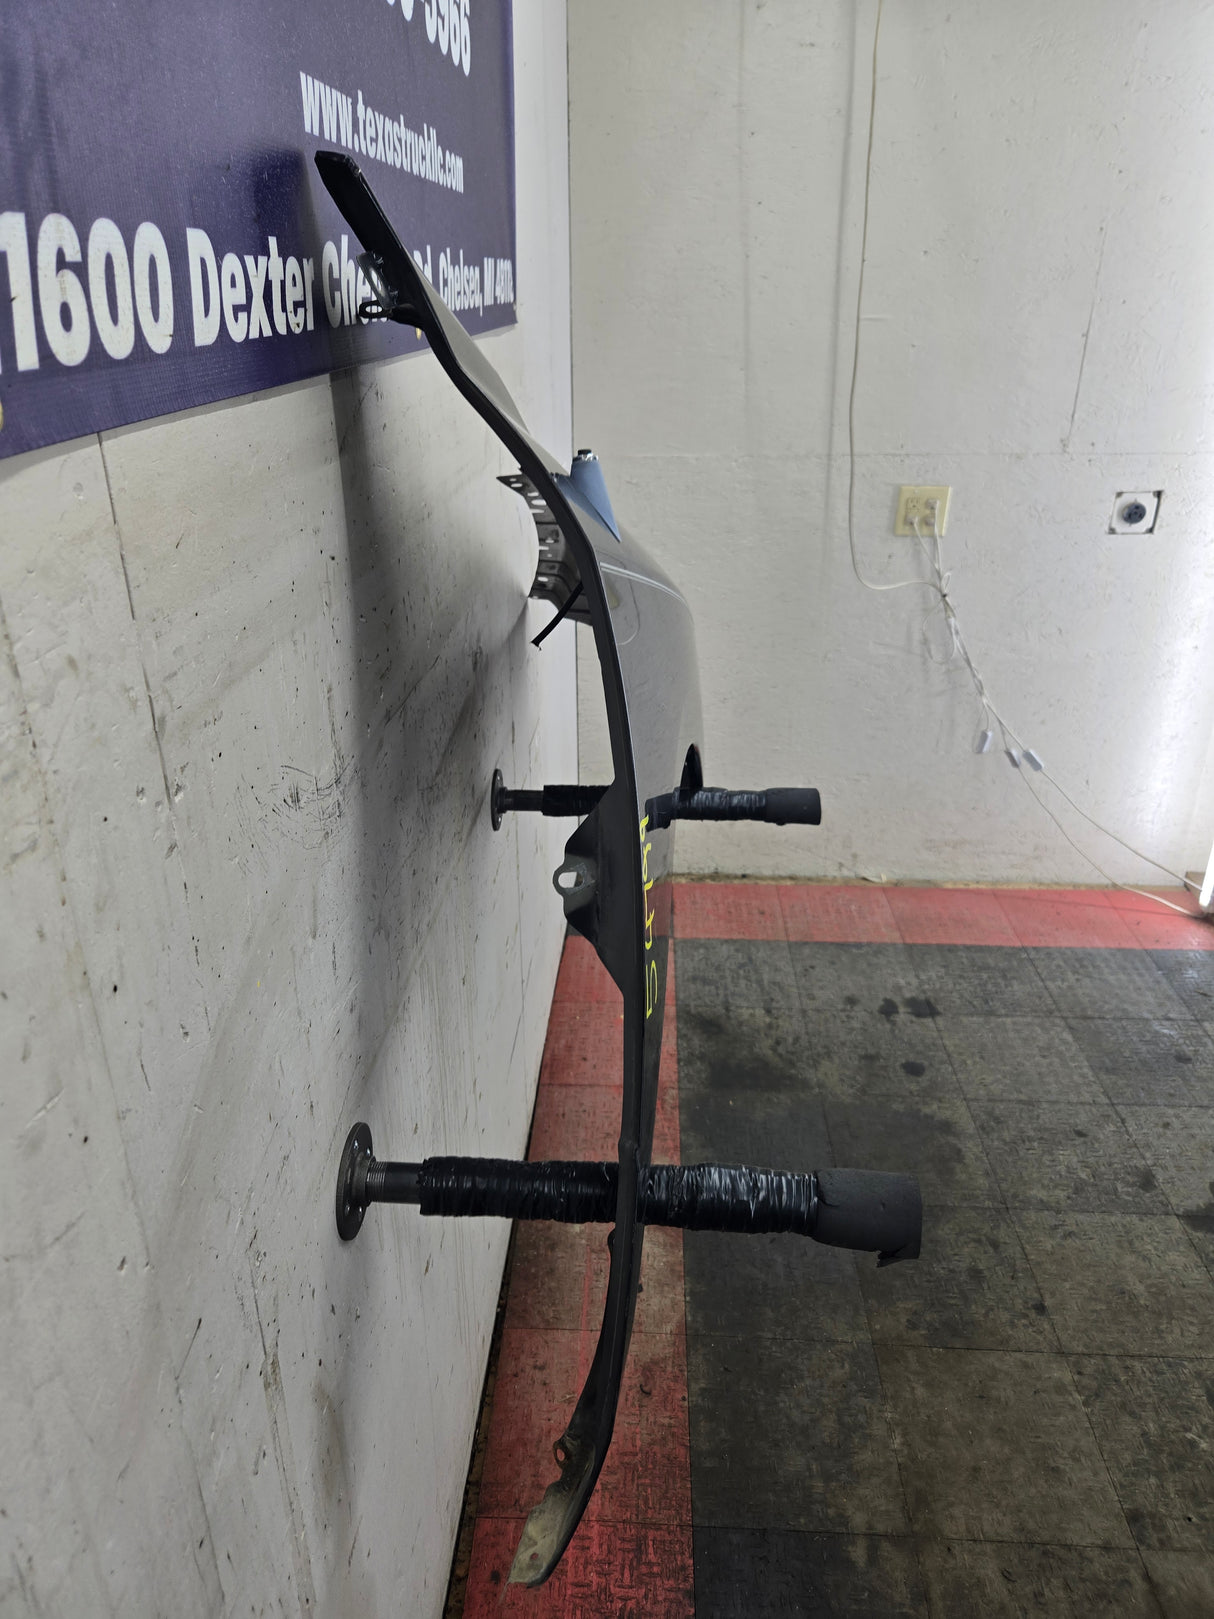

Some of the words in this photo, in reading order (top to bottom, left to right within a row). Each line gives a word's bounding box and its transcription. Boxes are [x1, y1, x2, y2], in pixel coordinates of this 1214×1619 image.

[299, 71, 464, 194] www.texastruckllc.com
[0, 210, 175, 375] 1600
[186, 227, 315, 348] Dexter
[439, 247, 483, 318] Chelsea,
[484, 256, 495, 307] MI
